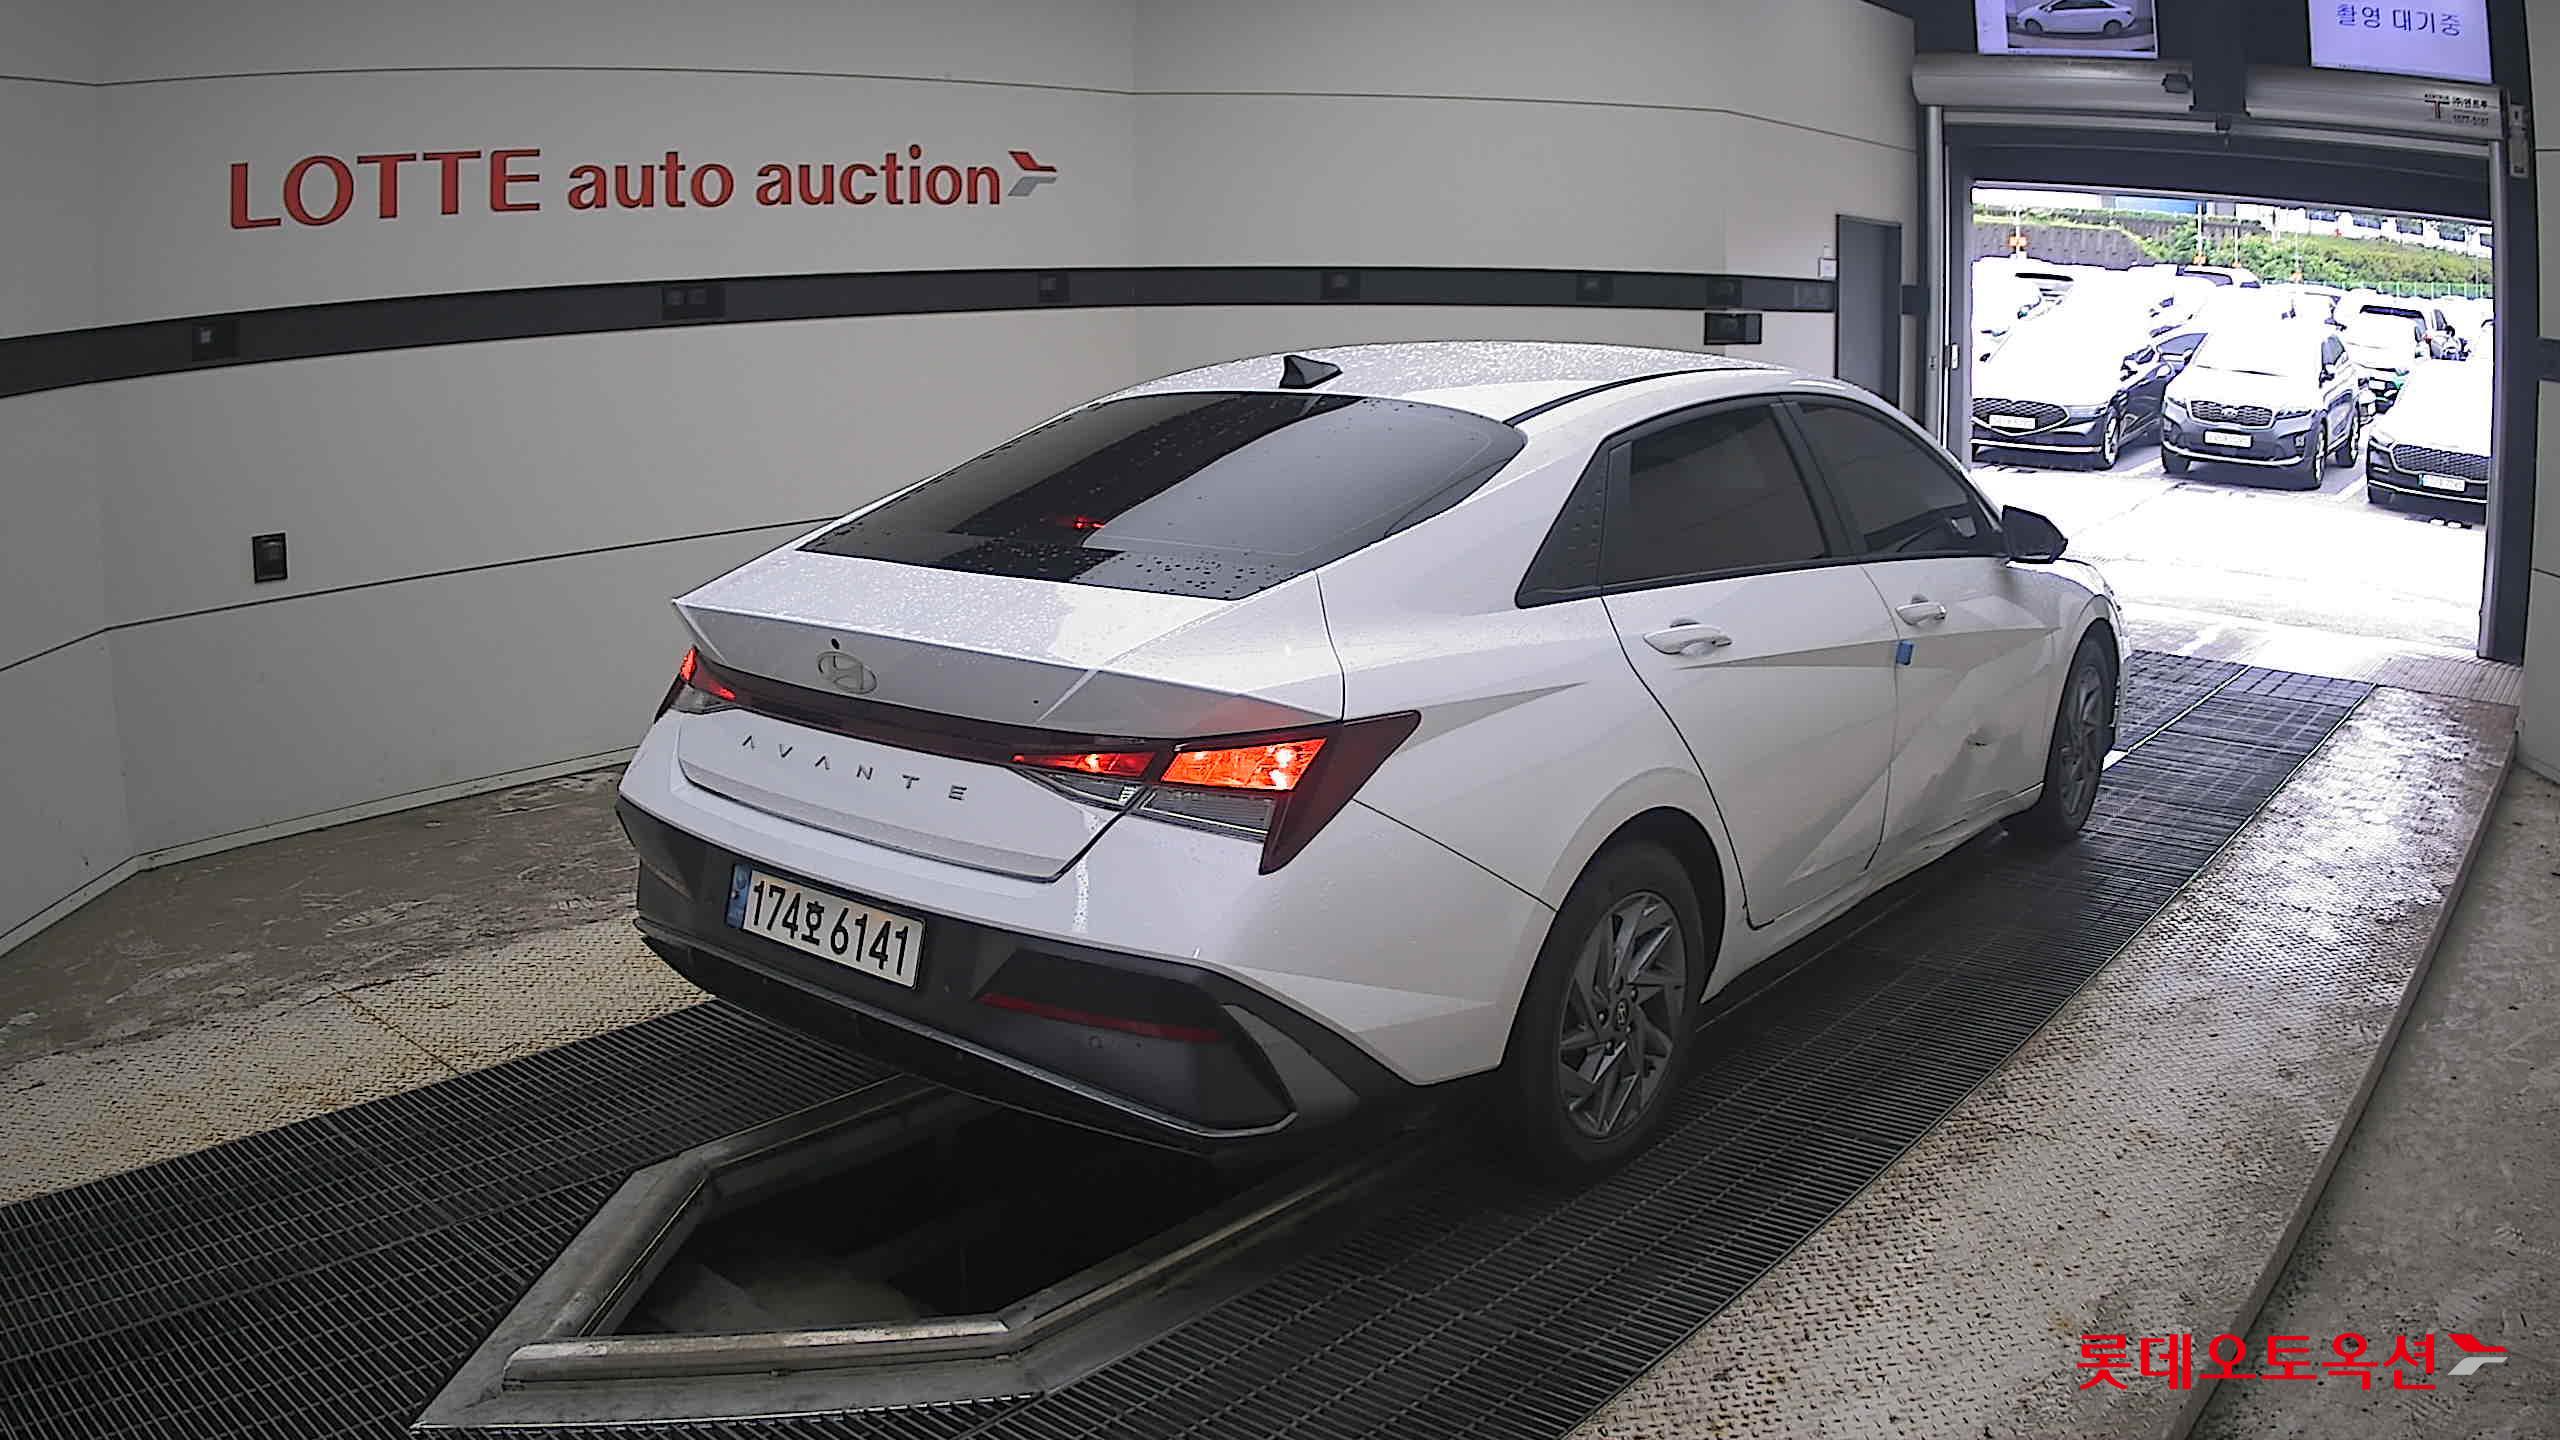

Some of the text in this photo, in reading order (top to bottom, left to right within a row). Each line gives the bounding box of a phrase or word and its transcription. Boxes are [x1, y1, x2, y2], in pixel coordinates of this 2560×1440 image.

[2336, 4, 2461, 36] 촬영 대기중
[229, 144, 1002, 231] LOTTE auto auction
[742, 735, 968, 801] AVANTE
[752, 879, 910, 977] 174호 6141
